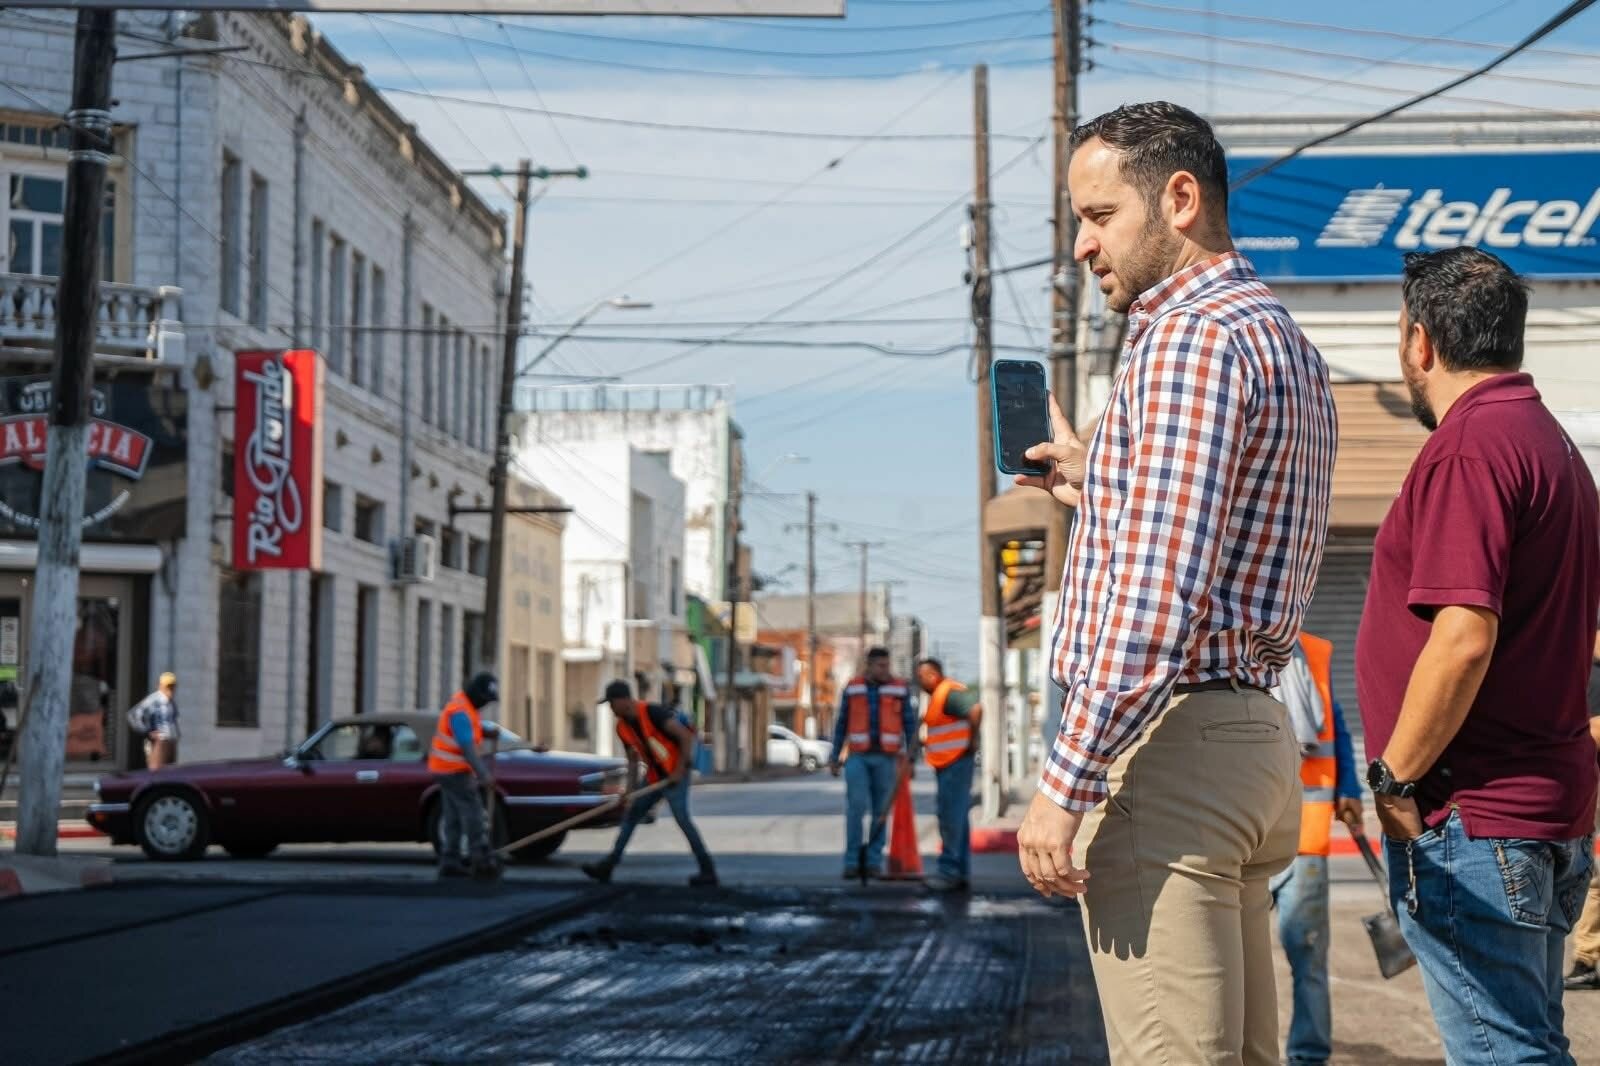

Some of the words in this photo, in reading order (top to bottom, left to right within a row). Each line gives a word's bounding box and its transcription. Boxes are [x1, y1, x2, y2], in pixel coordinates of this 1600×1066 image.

[1394, 187, 1600, 249] telcel
[243, 358, 303, 534] Grande
[248, 493, 282, 564] Rio
